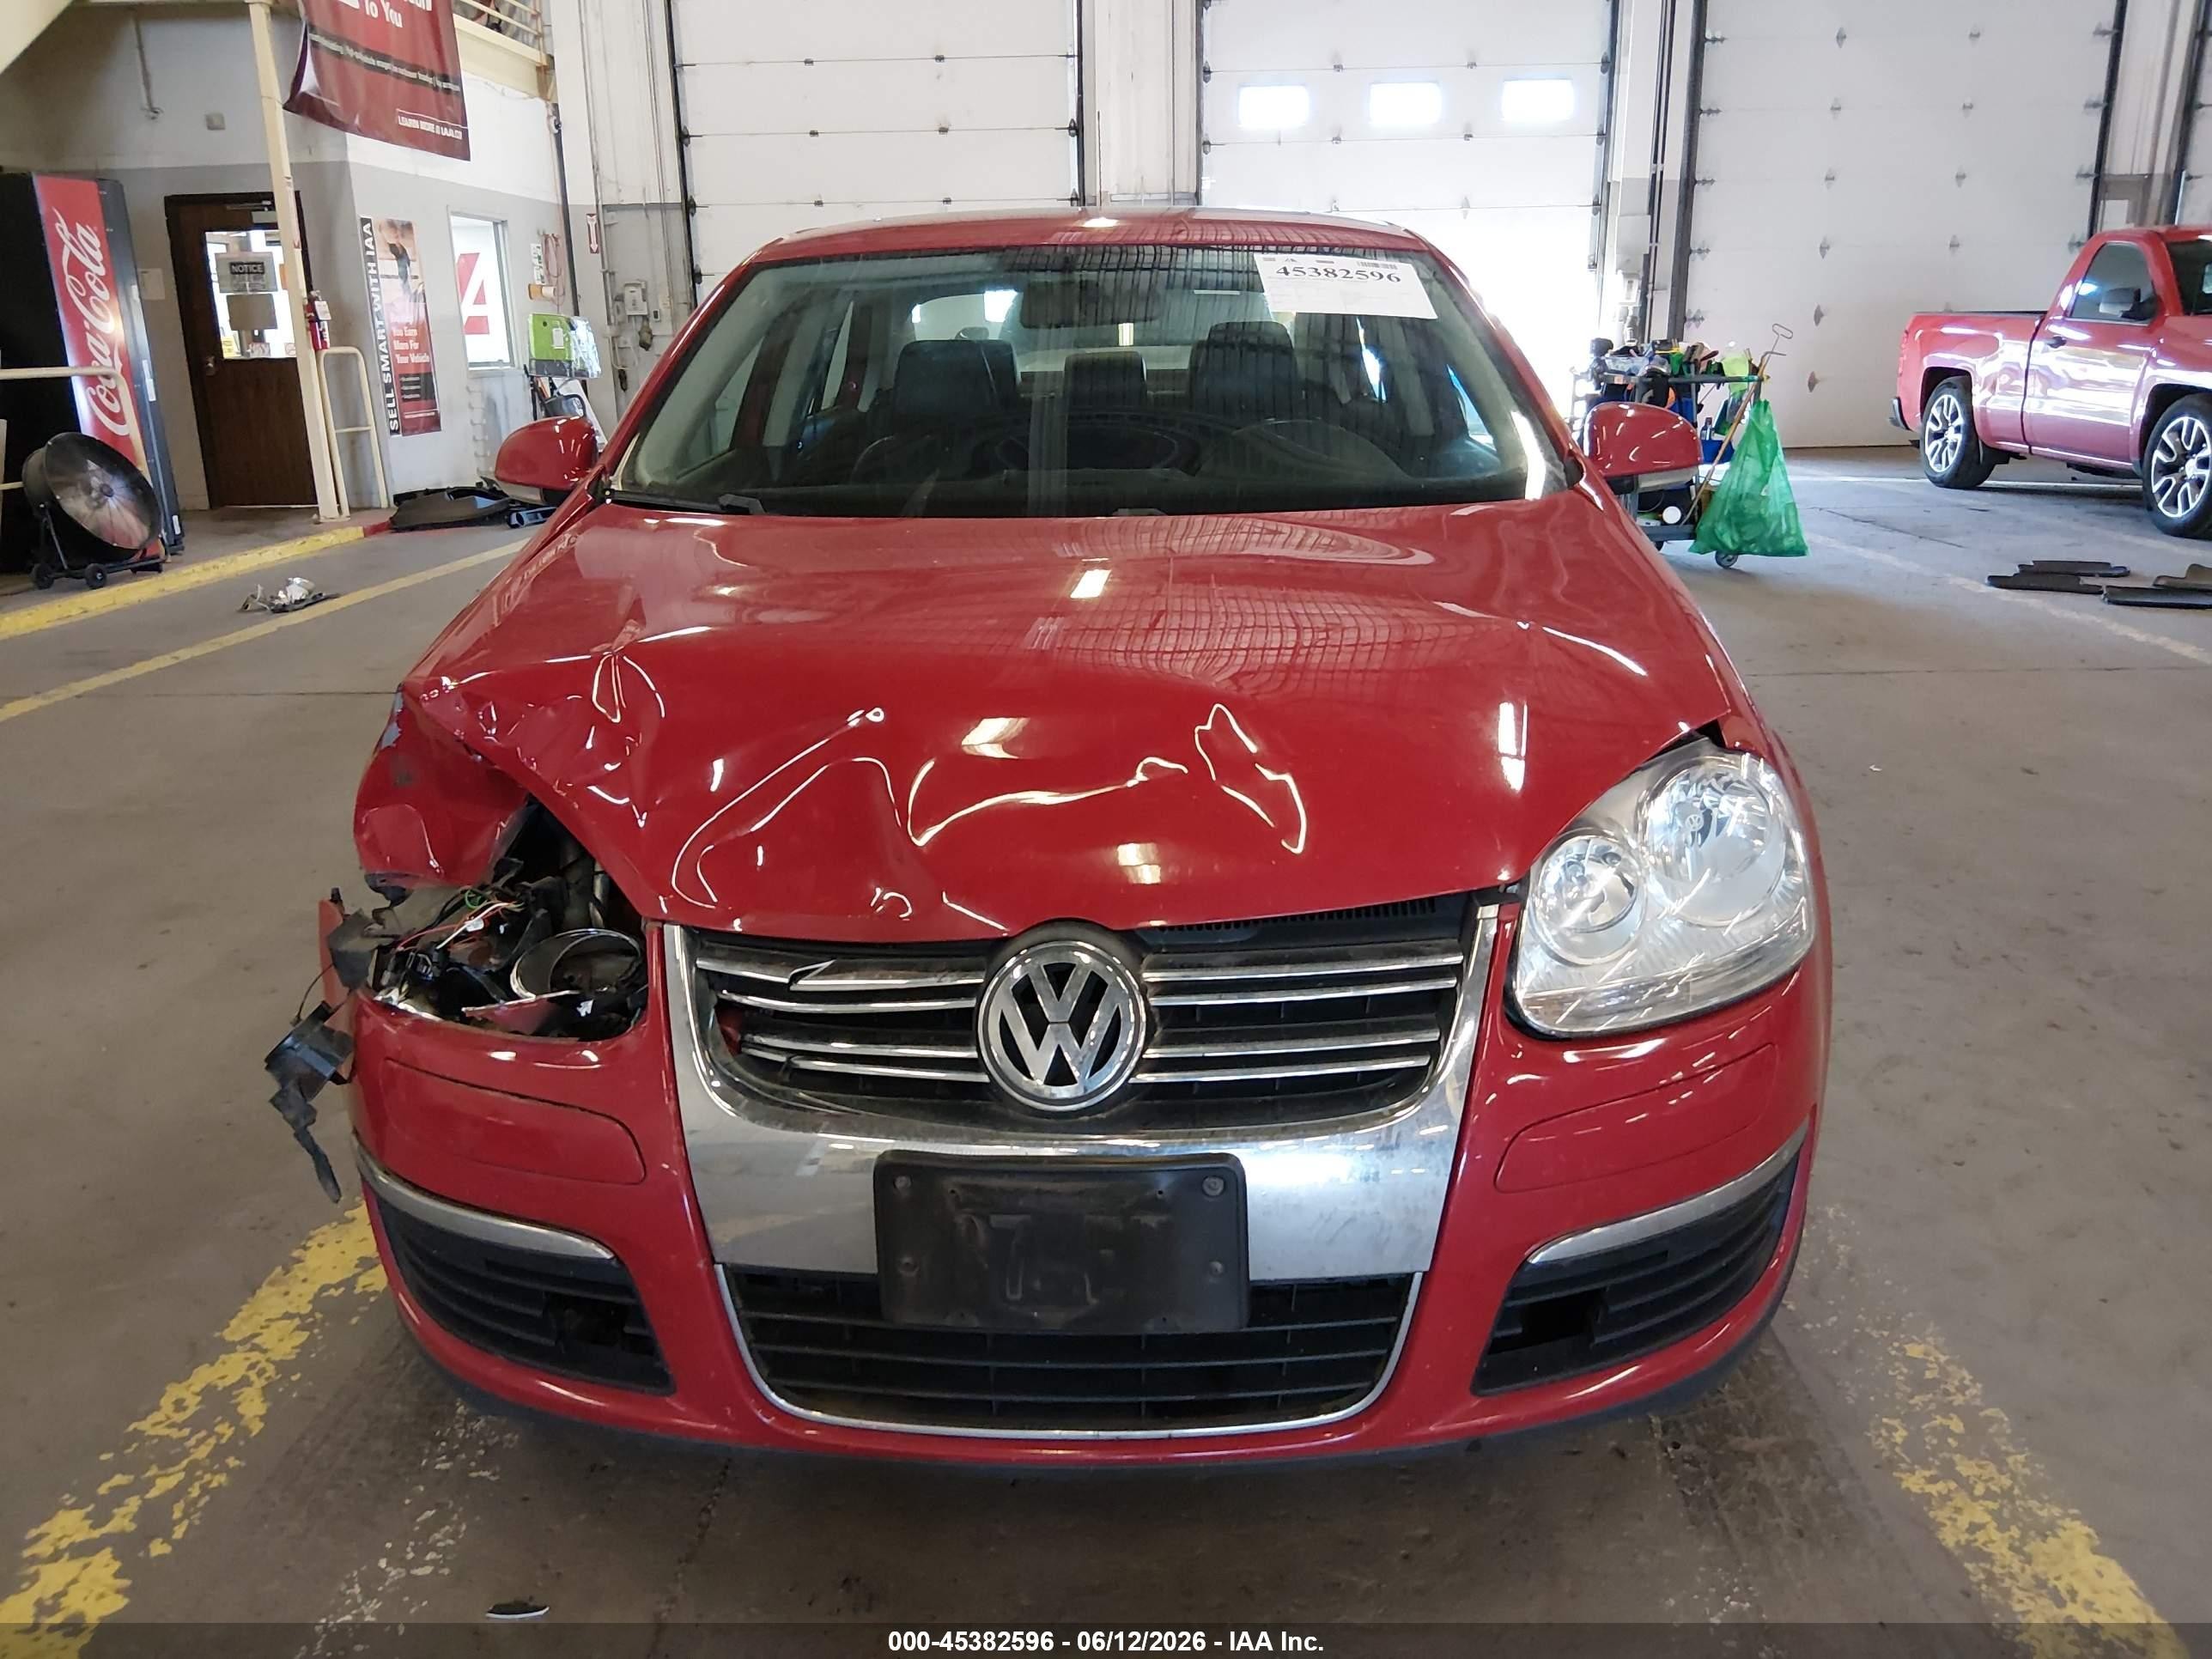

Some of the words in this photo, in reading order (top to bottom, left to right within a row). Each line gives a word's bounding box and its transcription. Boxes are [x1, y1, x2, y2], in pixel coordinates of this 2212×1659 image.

[363, 0, 379, 18] To
[380, 0, 404, 28] You
[362, 222, 375, 256] IAA
[231, 264, 264, 273] NOTICE
[1276, 266, 1401, 283] 45382596
[367, 262, 382, 312] WITH
[375, 319, 392, 384] SMART
[386, 388, 399, 431] SELL
